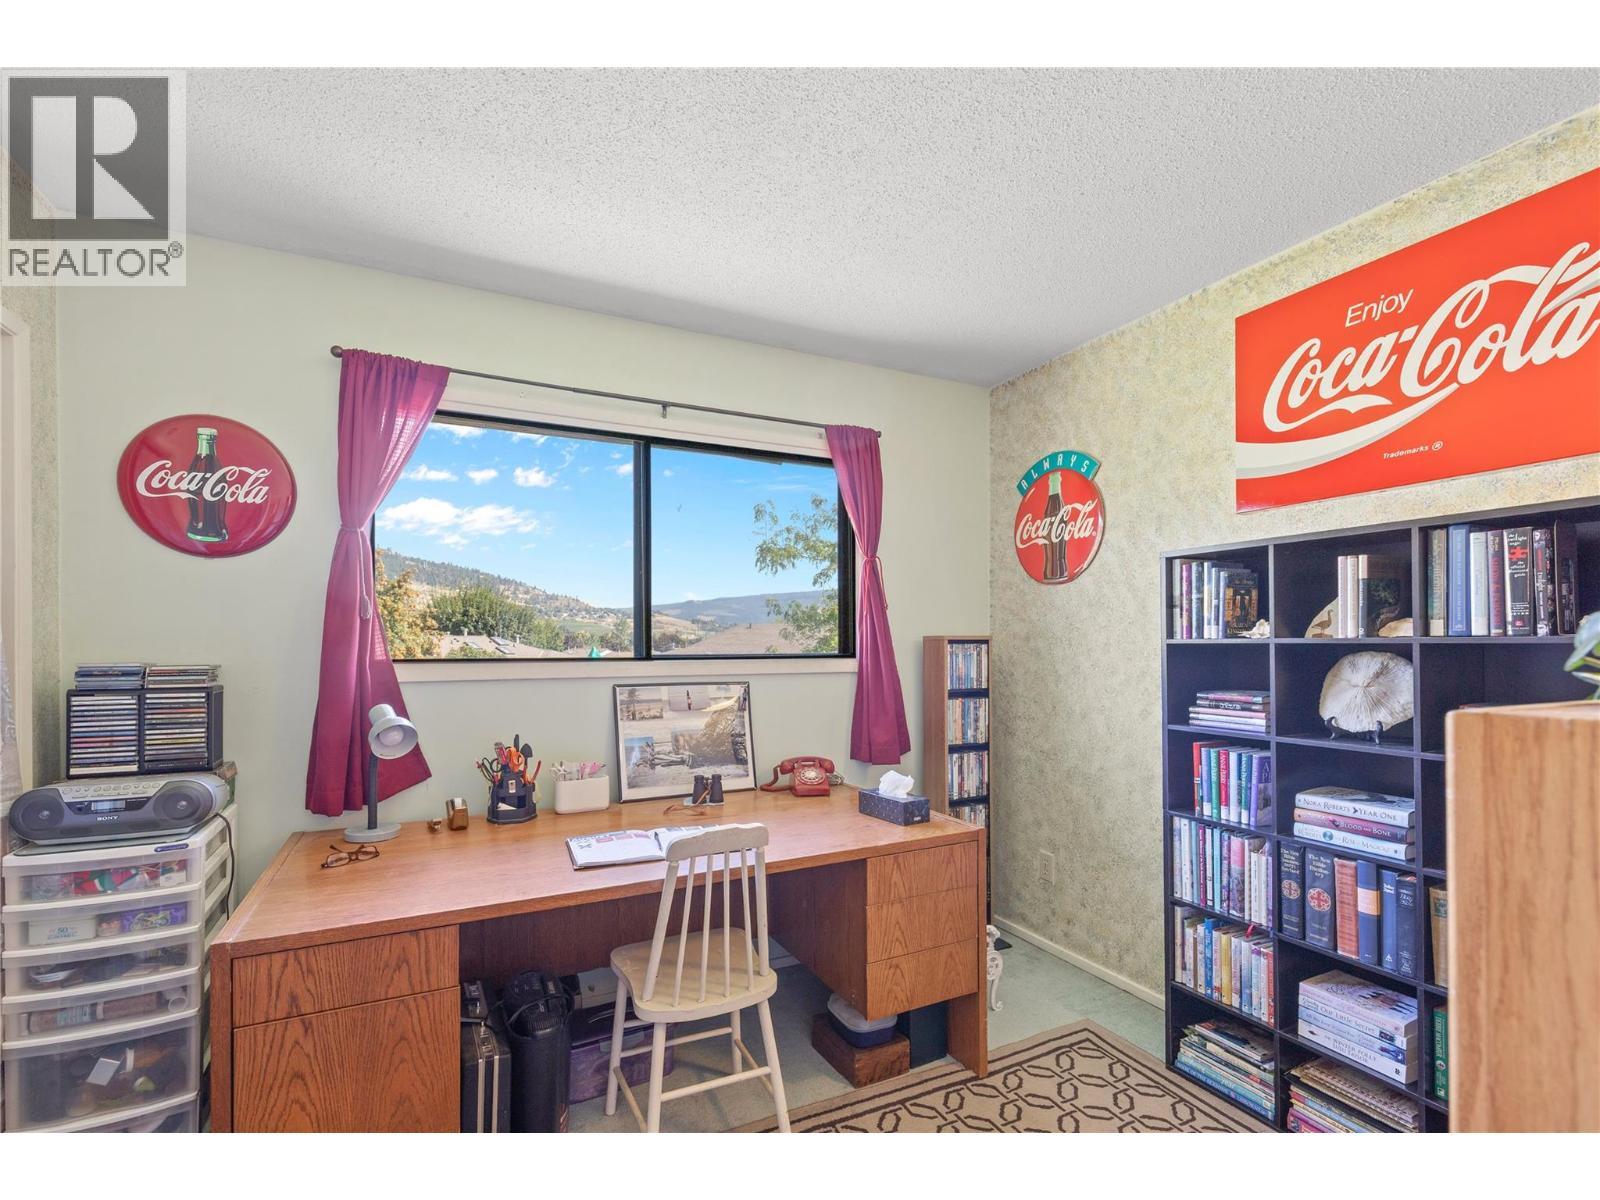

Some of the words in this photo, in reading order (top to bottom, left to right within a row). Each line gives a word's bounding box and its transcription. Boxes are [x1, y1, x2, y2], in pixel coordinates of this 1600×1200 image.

[1344, 289, 1414, 328] Enjoy
[1263, 241, 1600, 433] Coca-Cola
[1382, 444, 1429, 460] Trademarks
[135, 460, 272, 504] Coca-Cola
[1020, 453, 1090, 490] ALWAYS
[1016, 498, 1099, 549] Coca-Cola
[1303, 798, 1322, 808] NORA
[1323, 801, 1351, 813] ROBERTS
[1357, 806, 1378, 818] YEAR
[1379, 811, 1397, 821] ONE
[1372, 826, 1392, 838] BONE
